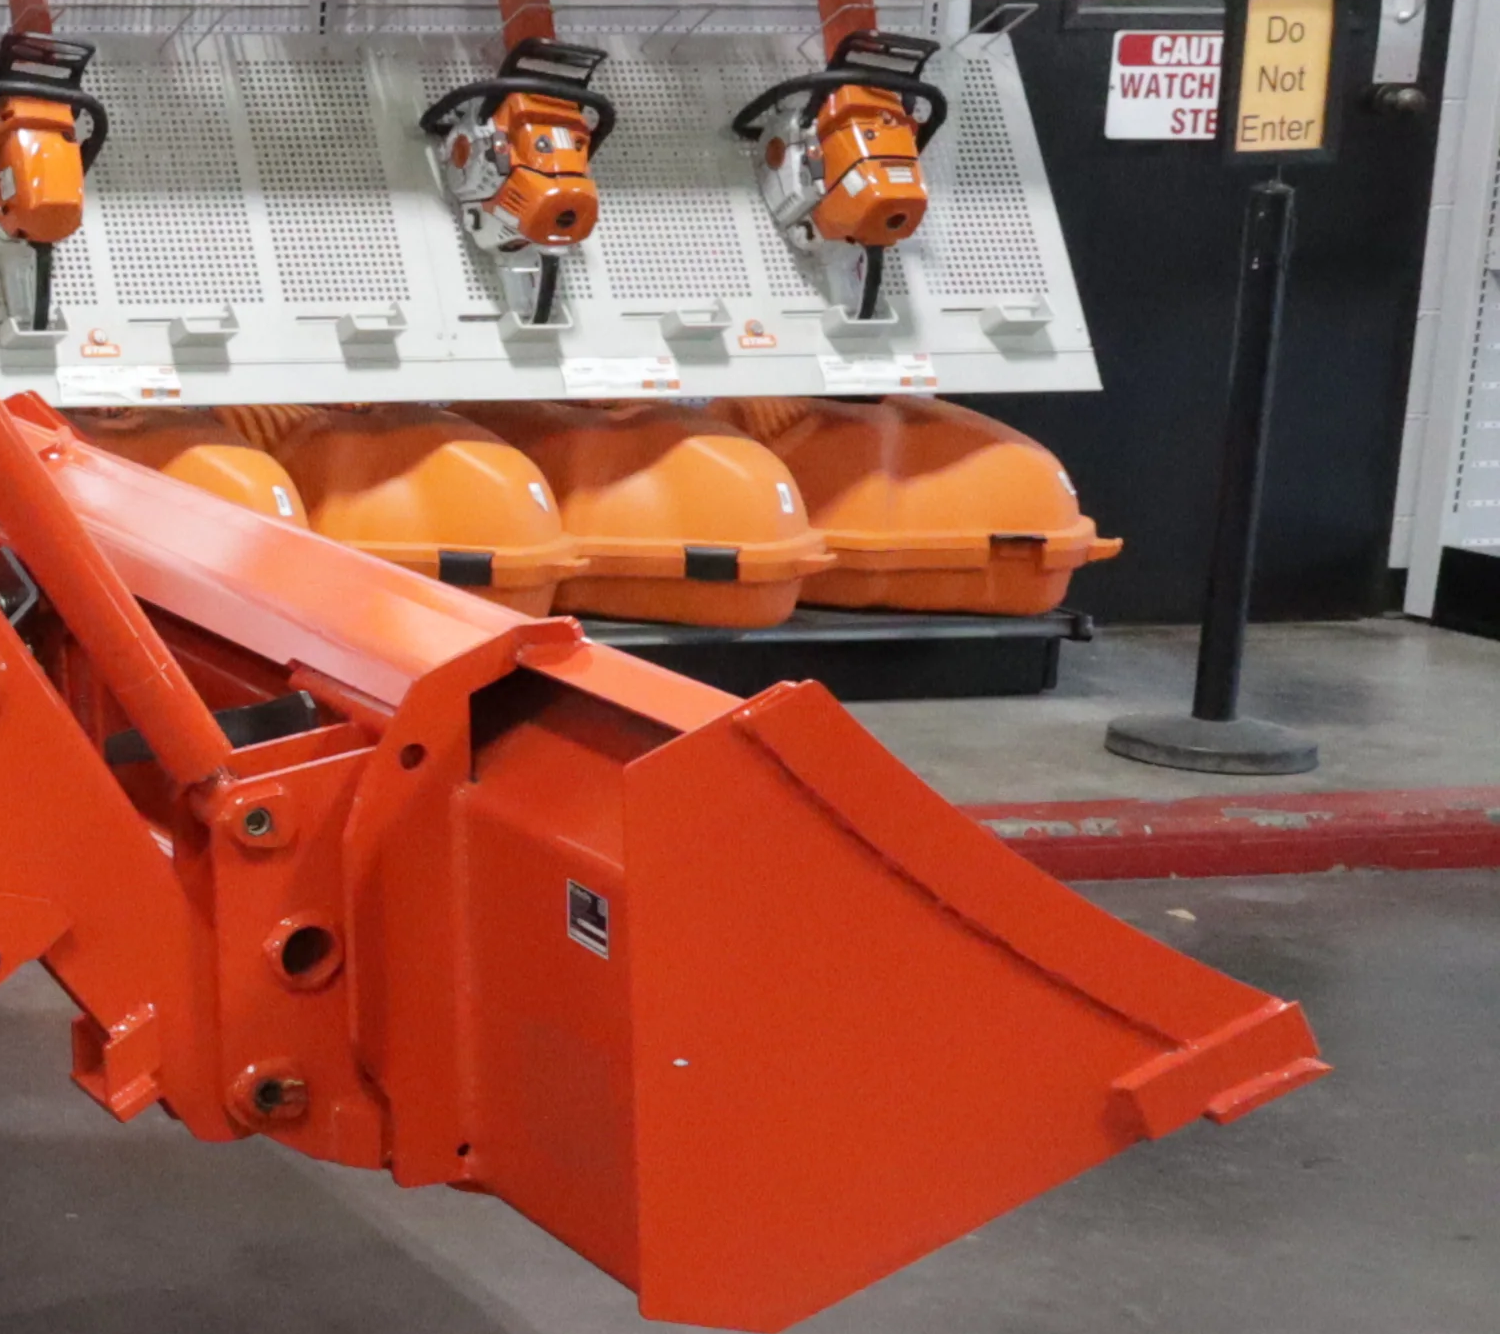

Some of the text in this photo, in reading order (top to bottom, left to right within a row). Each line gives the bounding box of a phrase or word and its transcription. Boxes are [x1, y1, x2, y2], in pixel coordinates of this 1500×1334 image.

[1266, 15, 1305, 44] Do
[1119, 73, 1215, 99] WATCH
[1257, 66, 1306, 93] Not
[1240, 114, 1316, 143] Enter
